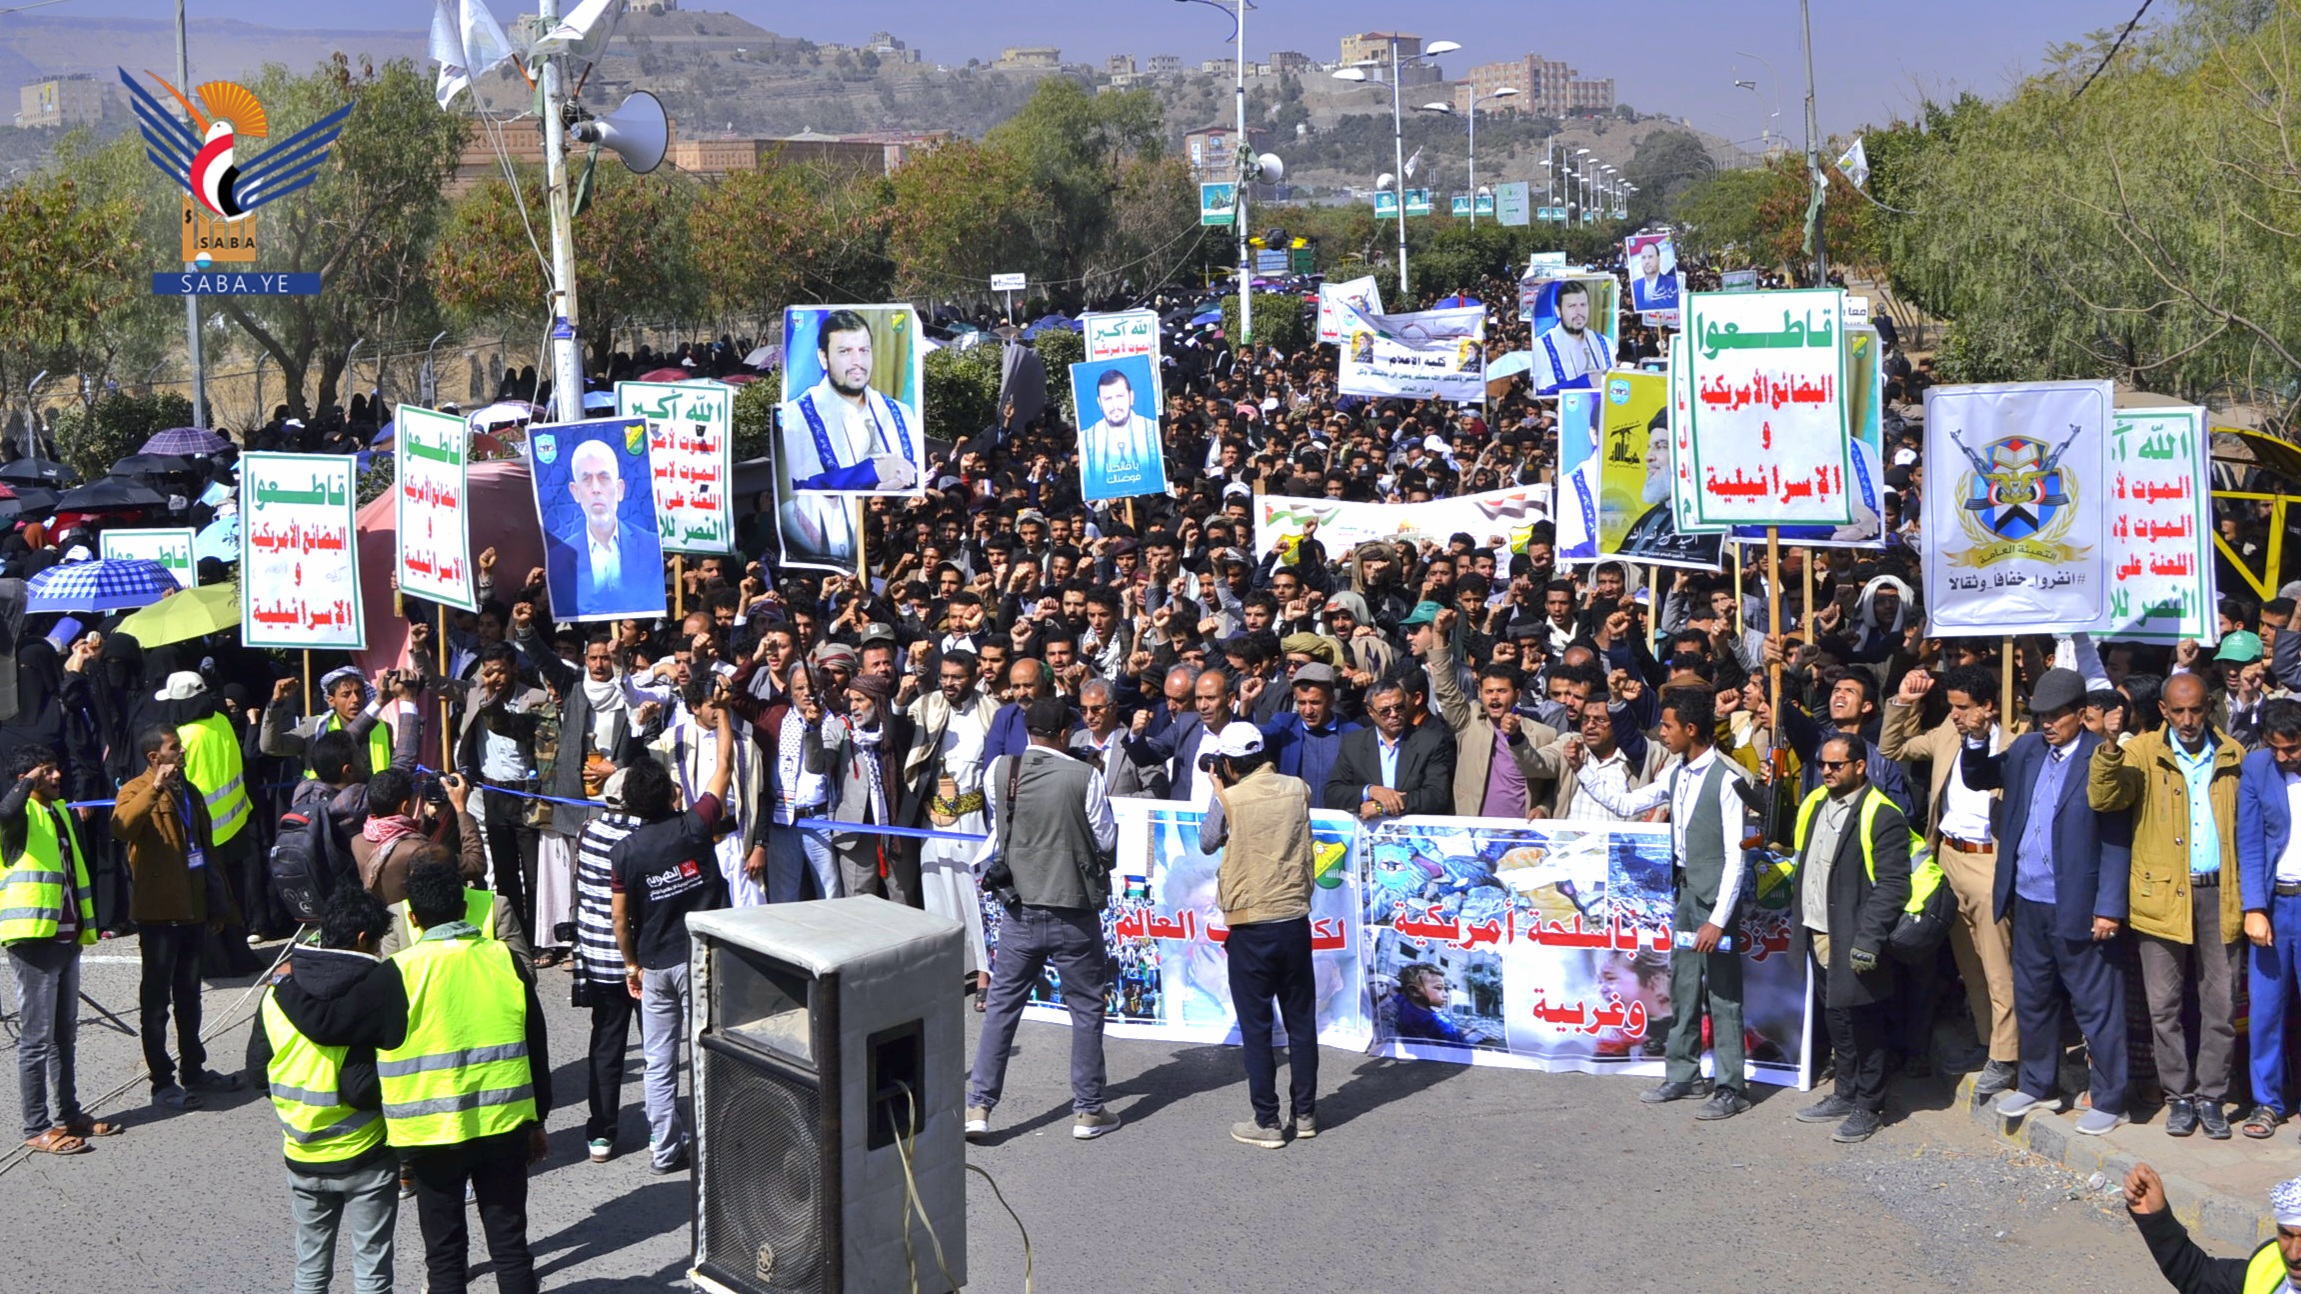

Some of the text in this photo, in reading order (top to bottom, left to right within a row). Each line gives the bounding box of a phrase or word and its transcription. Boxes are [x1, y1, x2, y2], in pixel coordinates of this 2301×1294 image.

[1131, 319, 1151, 335] الله
[1696, 308, 1833, 360] قاطعوا
[1700, 368, 1833, 411] البضائع الأمريكية
[685, 395, 722, 423] الله
[404, 423, 461, 466] قاطعوا
[679, 434, 721, 455] الموت
[1762, 421, 1772, 450] و
[2138, 424, 2189, 460] الله
[679, 461, 721, 485] الموت
[1706, 464, 1842, 504] الإسرائيلية
[251, 471, 346, 511] قاطعوا
[432, 481, 461, 513] البضائع
[665, 490, 684, 510] على
[690, 491, 721, 511] اللعنة
[2131, 475, 2191, 504] الموت
[251, 518, 347, 556] البضائع الأمريكية
[427, 516, 433, 539] و
[681, 516, 724, 545] النصر
[2133, 514, 2193, 543] الموت
[404, 545, 466, 586] الإسرائيلية
[1978, 544, 2058, 564] التعبئة العامة
[2116, 552, 2194, 581] اللعنة على
[294, 561, 302, 587] و
[253, 596, 353, 631] الإسرائيلية
[2138, 584, 2196, 628] النصر
[1114, 908, 1196, 947] العالم
[1393, 898, 1515, 951] أمريكية
[1526, 907, 1640, 961] بأسلحة
[1532, 987, 1648, 1039] وغربية
